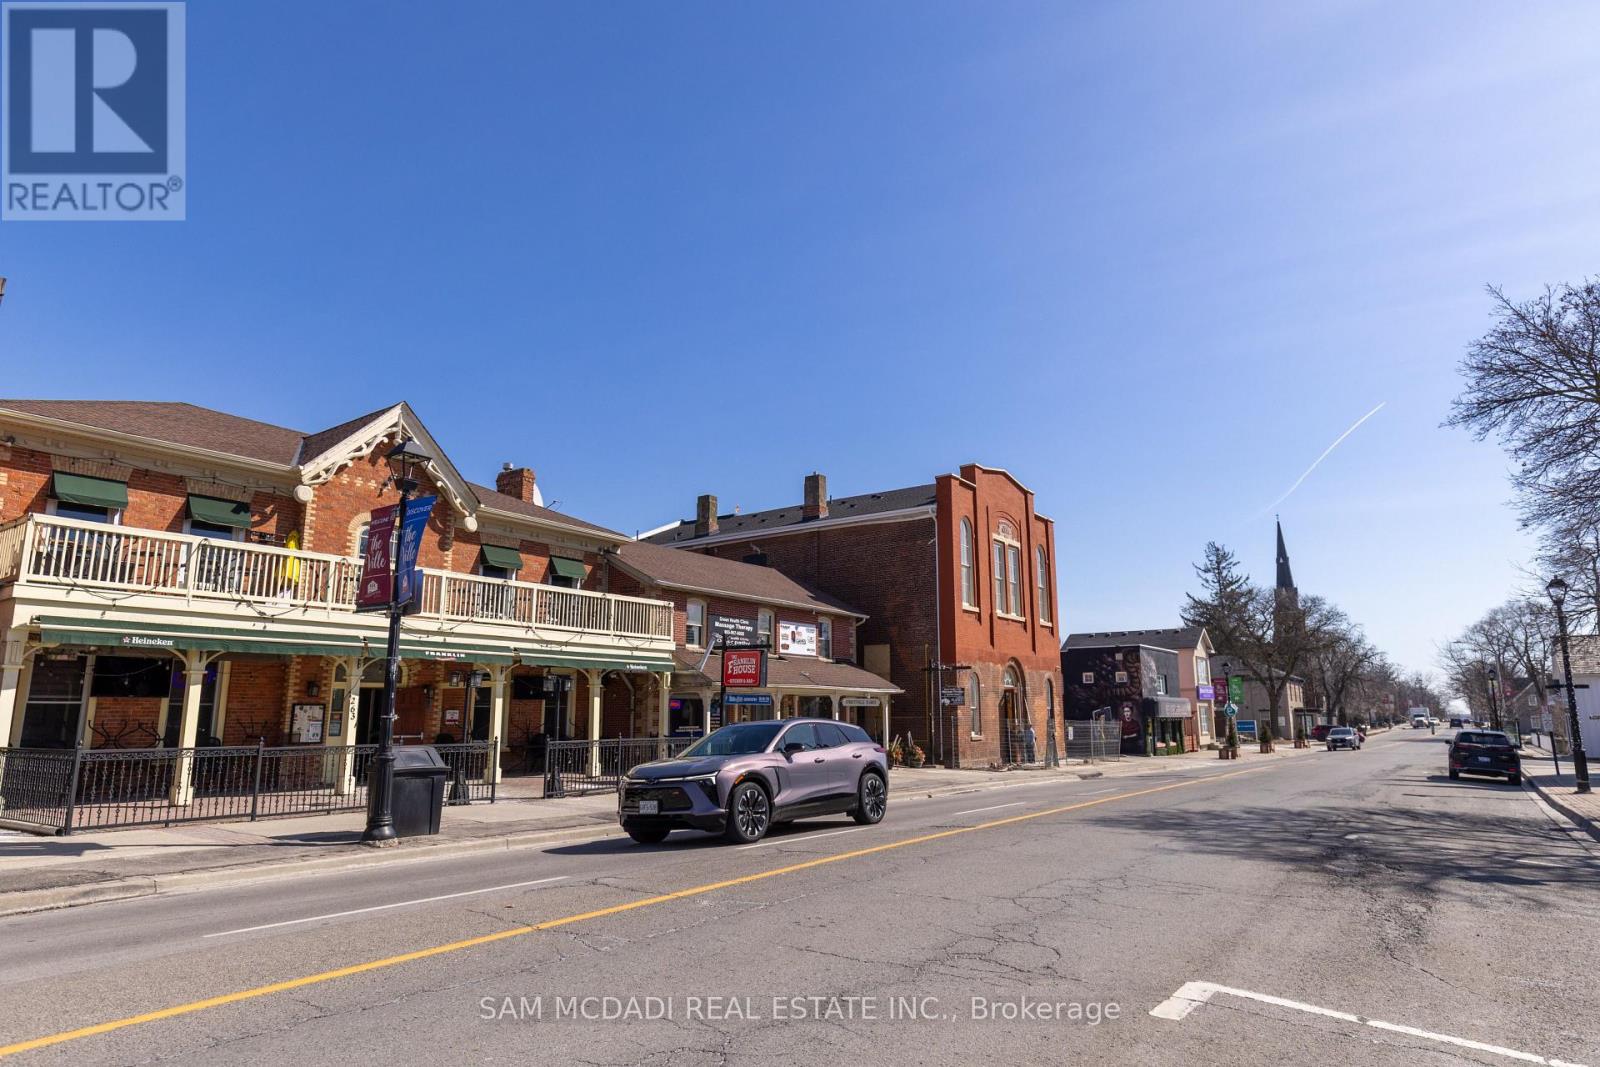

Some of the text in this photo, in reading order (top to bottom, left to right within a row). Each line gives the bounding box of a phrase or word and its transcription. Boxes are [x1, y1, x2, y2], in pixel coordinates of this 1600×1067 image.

[371, 534, 382, 553] the
[367, 551, 386, 571] Ville
[714, 621, 753, 632] Massage Therapy
[132, 636, 173, 646] Heineken
[733, 665, 756, 675] HOUSE
